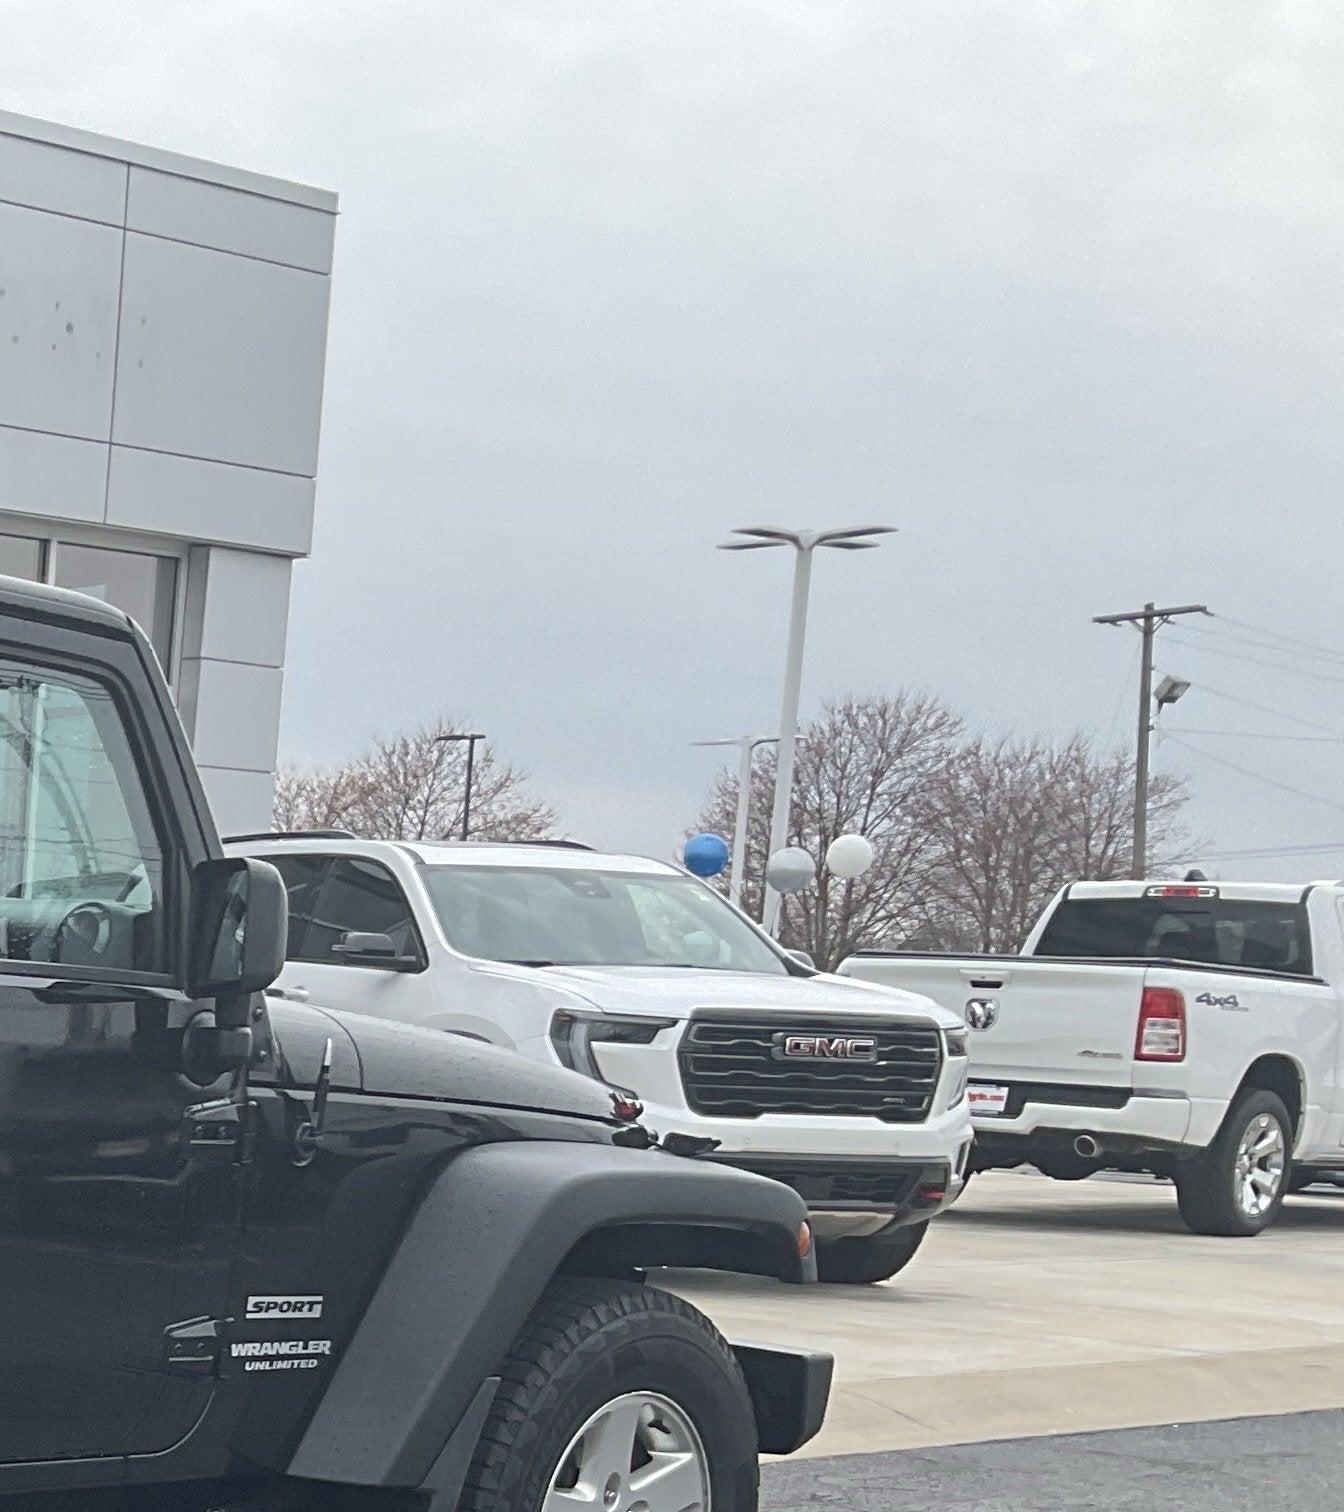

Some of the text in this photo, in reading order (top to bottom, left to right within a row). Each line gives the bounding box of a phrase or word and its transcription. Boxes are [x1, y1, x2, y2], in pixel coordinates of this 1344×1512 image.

[784, 1036, 875, 1058] GMC
[251, 1300, 322, 1313] SPORT
[230, 1340, 332, 1357] WRANGLER
[244, 1359, 318, 1371] UNLIMITED
